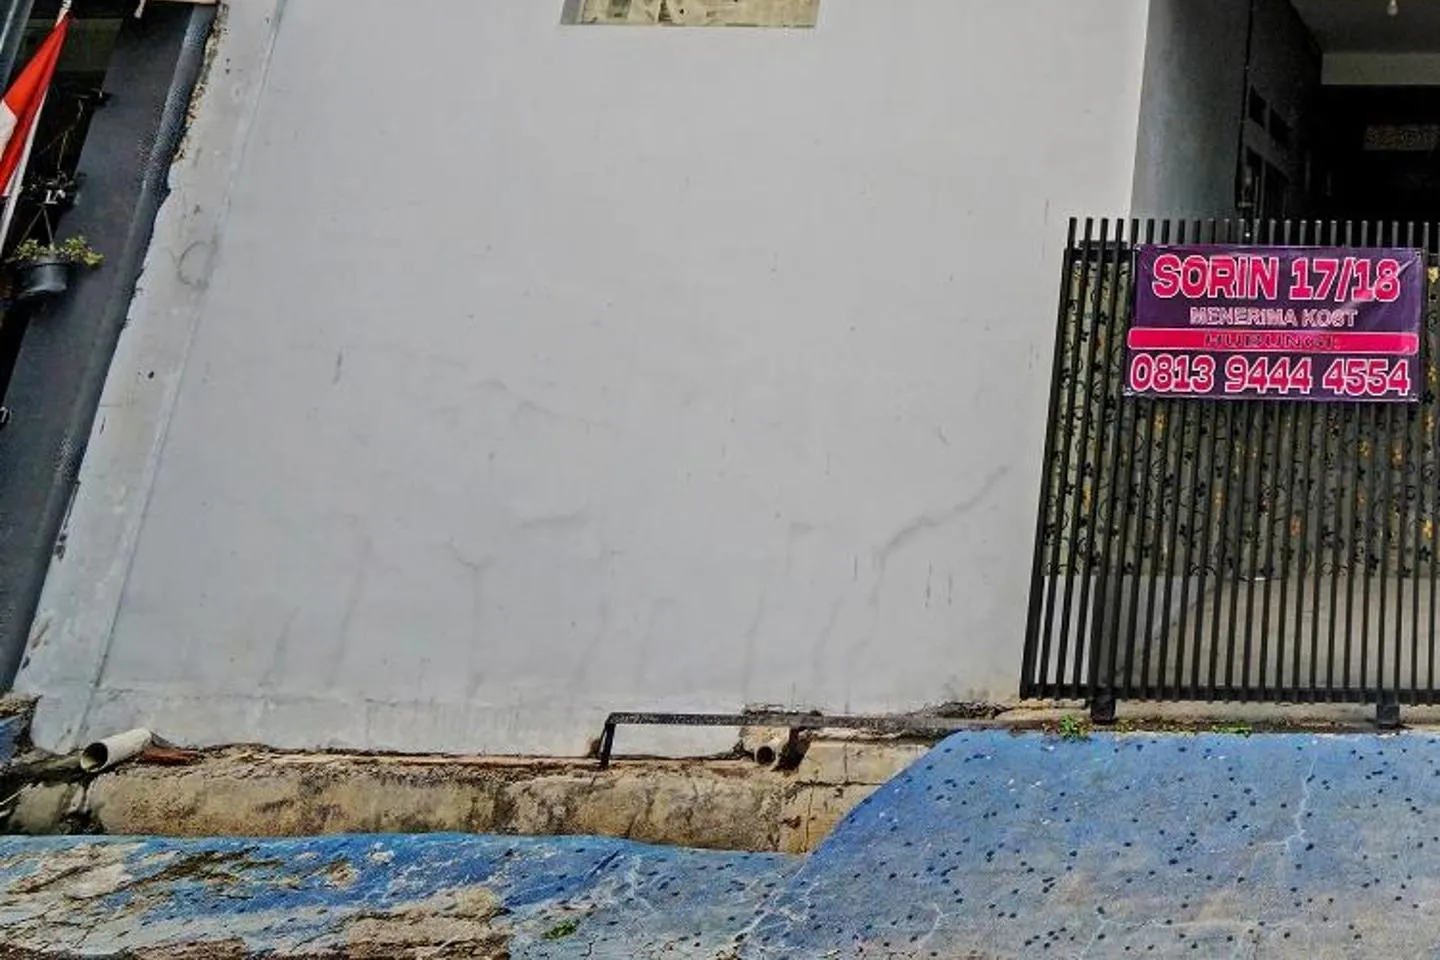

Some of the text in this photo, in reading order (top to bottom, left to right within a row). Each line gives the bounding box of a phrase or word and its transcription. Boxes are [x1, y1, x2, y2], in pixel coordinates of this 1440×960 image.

[1152, 254, 1401, 302] SORIN 17/18
[1190, 306, 1358, 328] MENERIMA KOST
[1130, 353, 1411, 396] 0813 9444 4554
